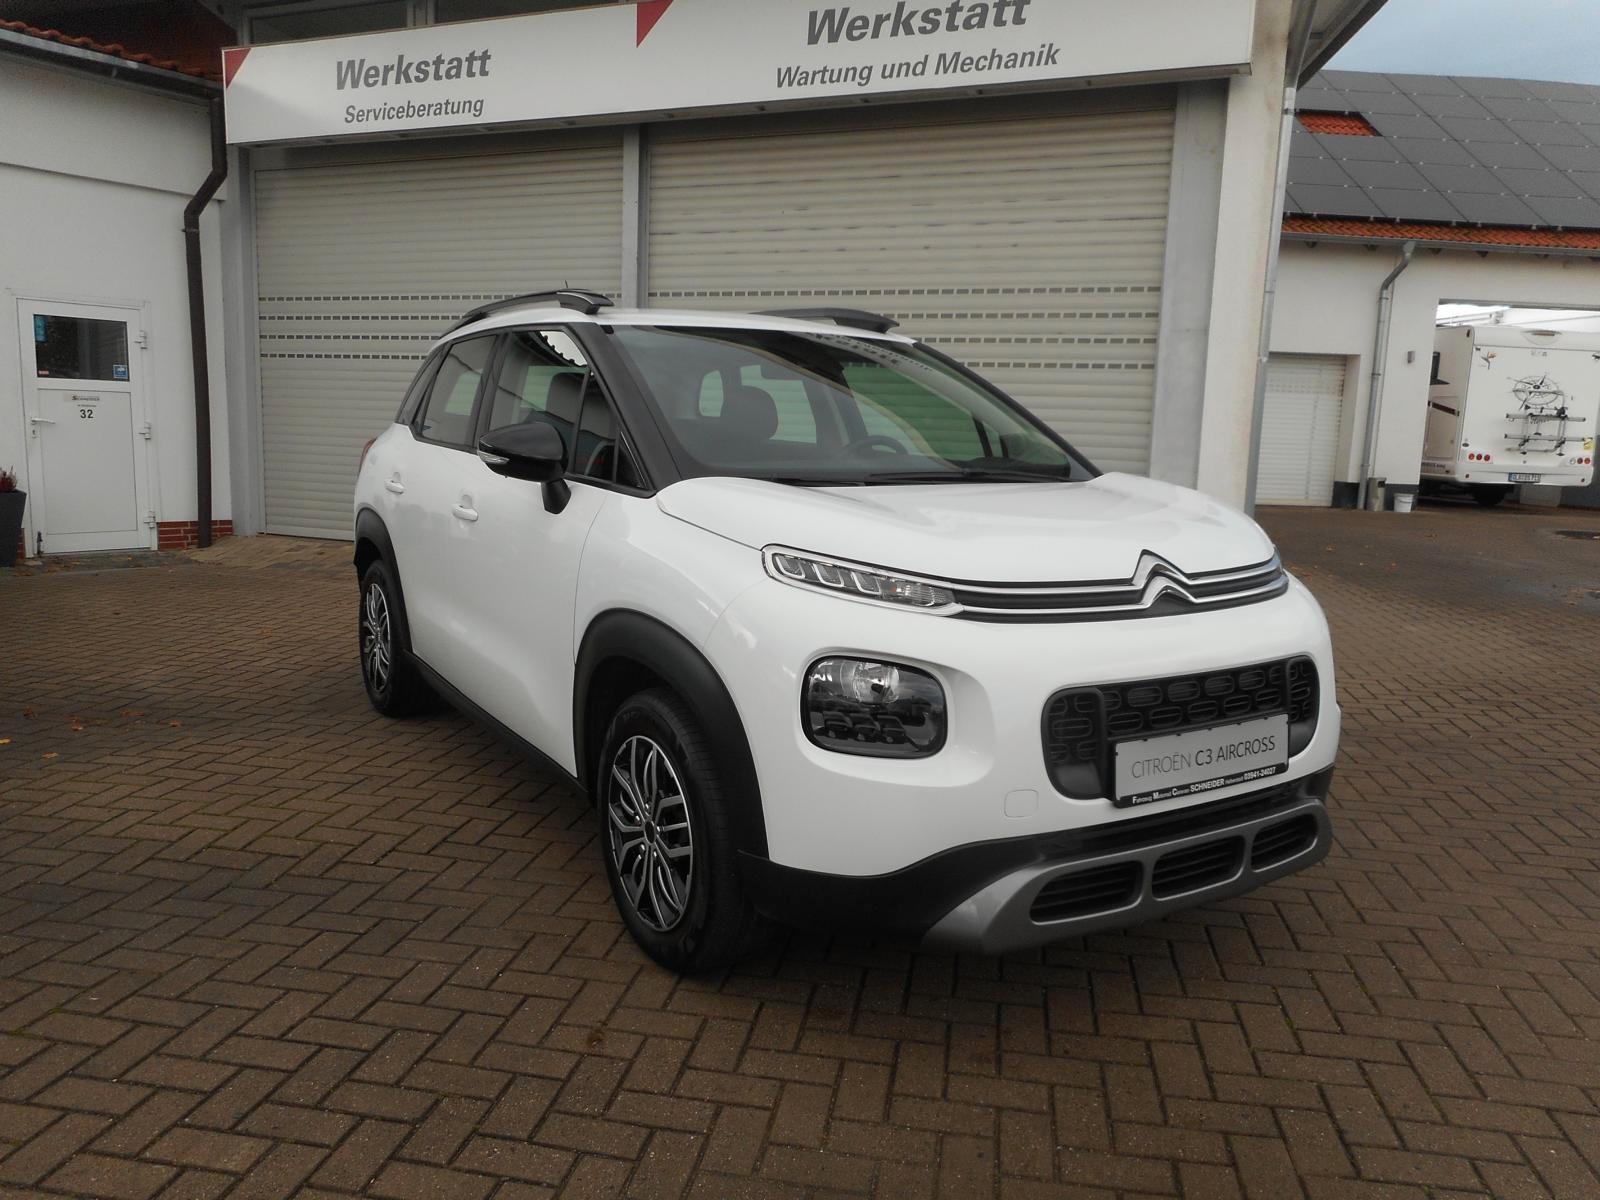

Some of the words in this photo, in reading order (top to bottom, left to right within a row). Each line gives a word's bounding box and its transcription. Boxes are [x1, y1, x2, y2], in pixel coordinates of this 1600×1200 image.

[807, 0, 1031, 46] Werkstatt
[336, 48, 492, 91] Werkstatt
[775, 62, 873, 88] Wartung
[880, 54, 929, 80] und
[934, 43, 1061, 76] Mechanik
[344, 98, 484, 124] Serviceberatung
[79, 409, 94, 419] 32
[1132, 752, 1192, 779] CITROËN
[1195, 748, 1213, 767] C3
[1216, 735, 1276, 763] AIRCROSS
[1189, 778, 1225, 793] SCHNEIDER
